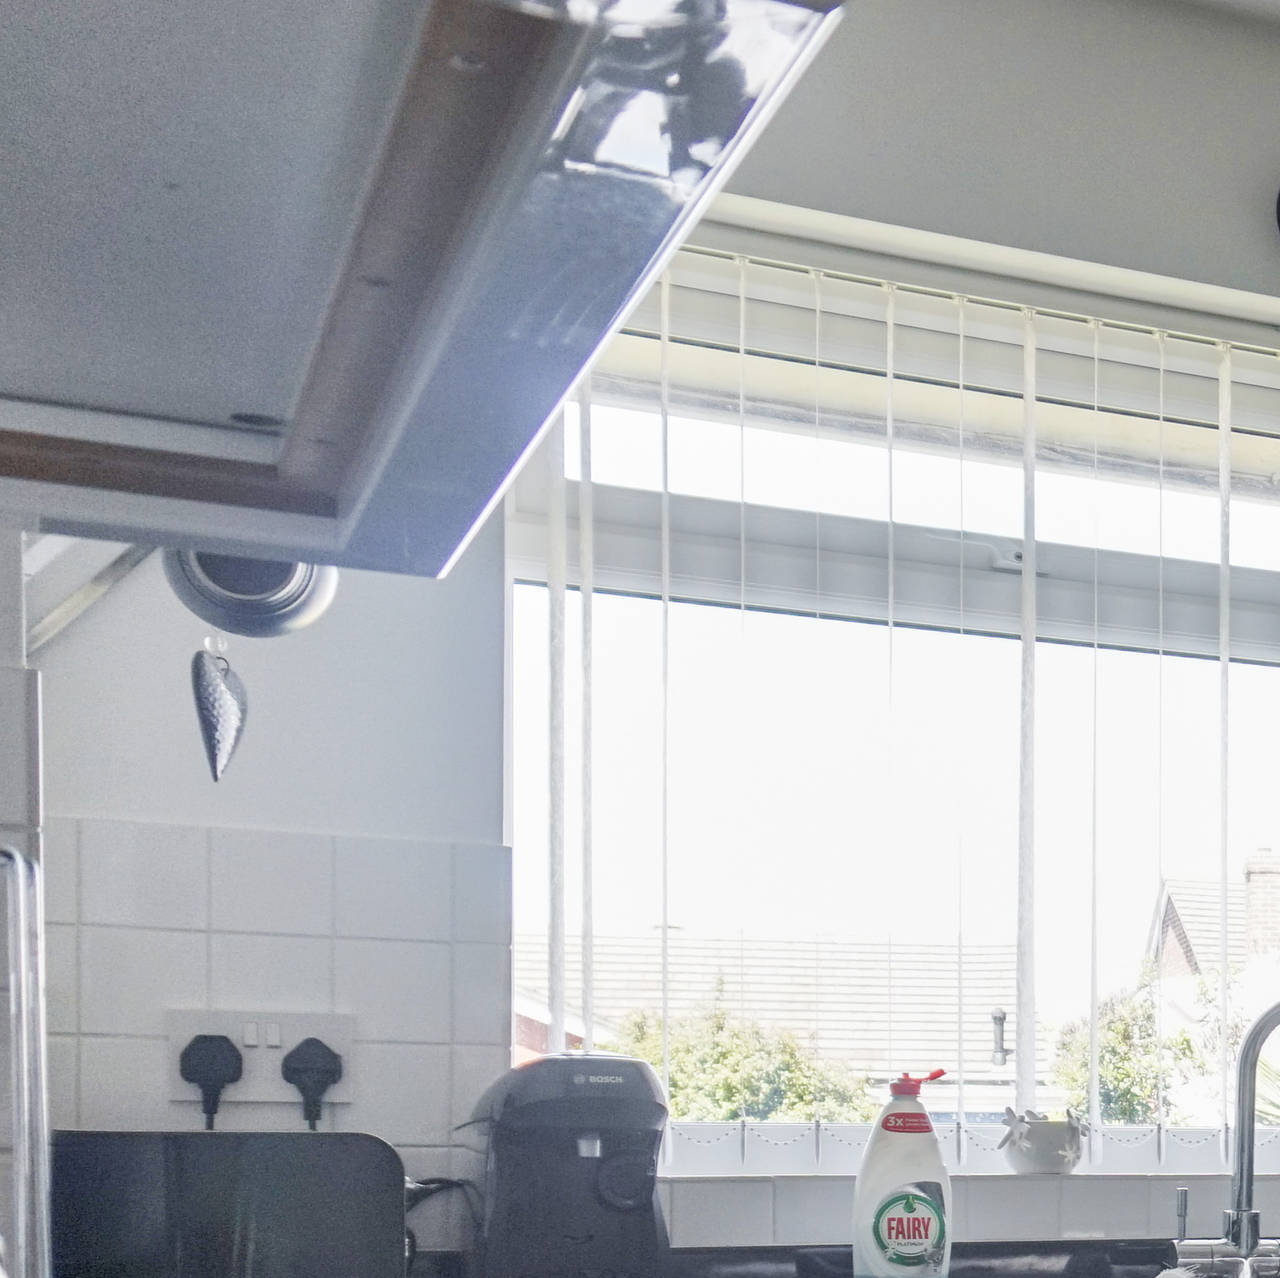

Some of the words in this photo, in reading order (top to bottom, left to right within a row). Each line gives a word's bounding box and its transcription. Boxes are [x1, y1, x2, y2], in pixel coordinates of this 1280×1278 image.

[589, 1075, 623, 1083] BOSCH
[887, 1116, 904, 1126] 3x
[887, 1217, 931, 1240] FAIRY
